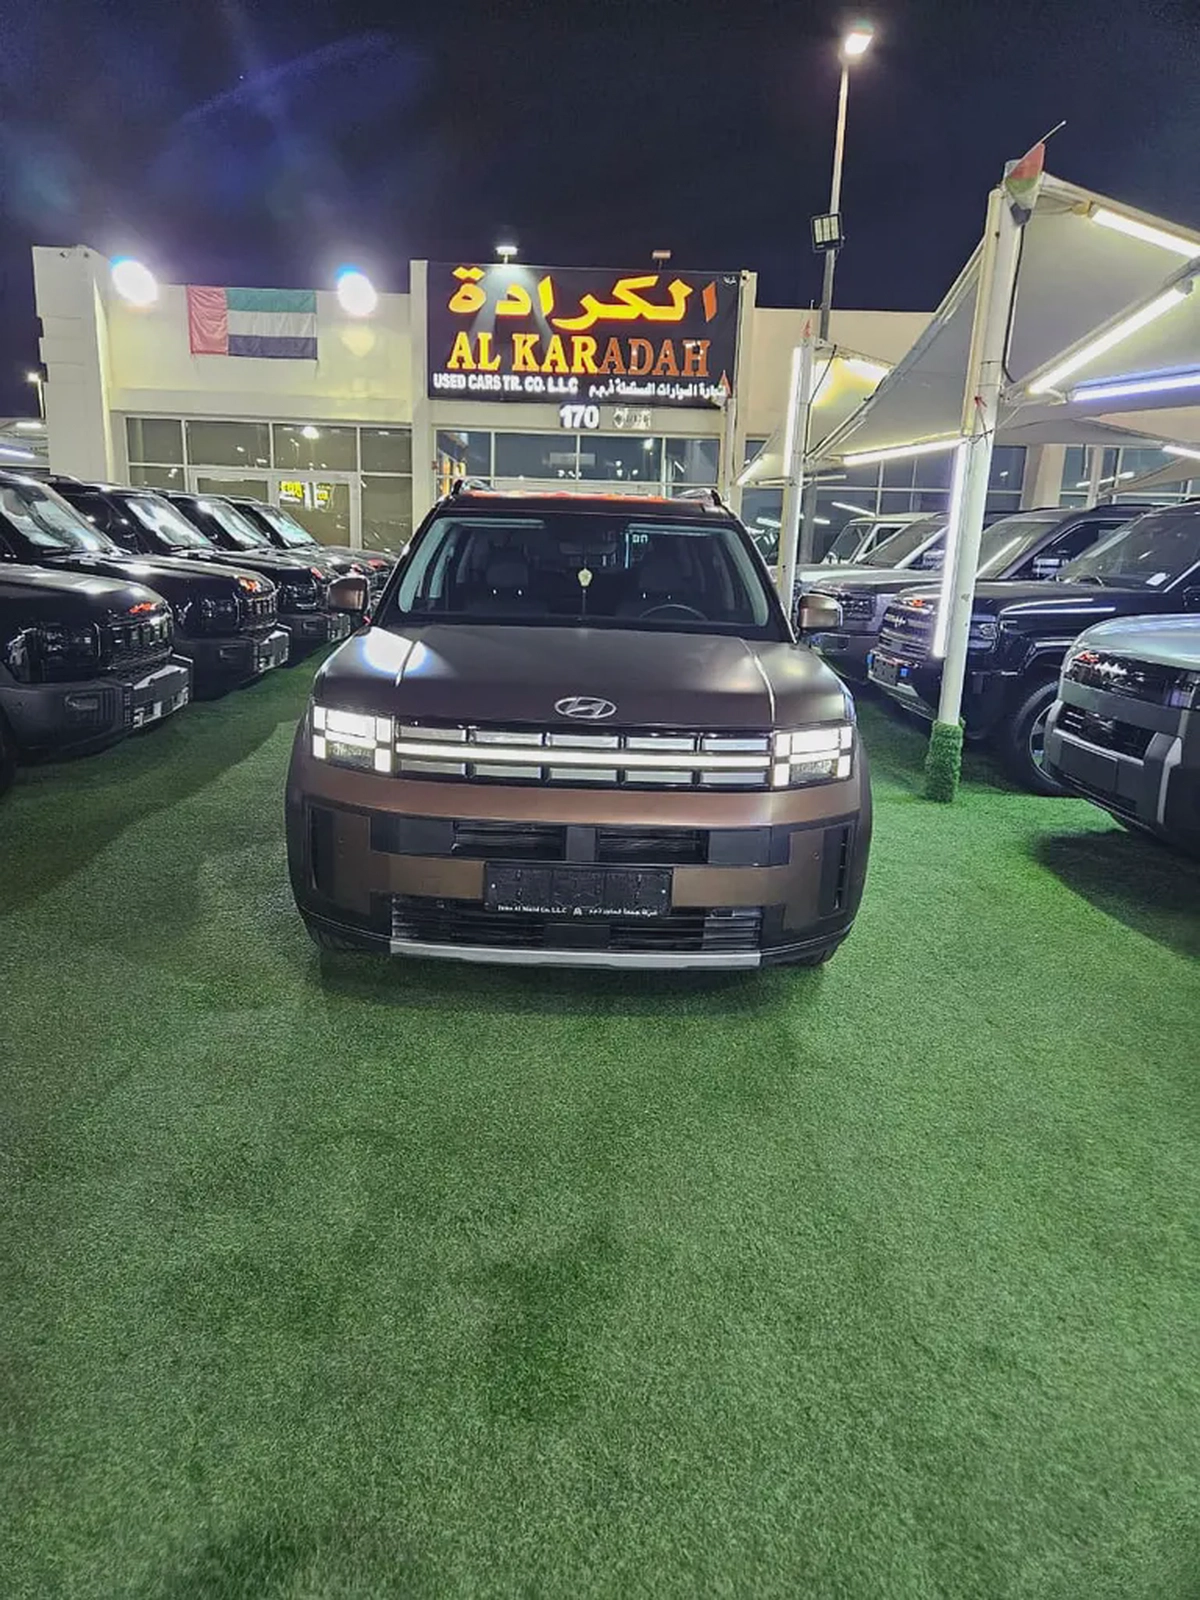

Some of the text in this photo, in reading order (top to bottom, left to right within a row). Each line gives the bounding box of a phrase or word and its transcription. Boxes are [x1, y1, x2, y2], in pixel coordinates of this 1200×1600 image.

[448, 265, 717, 331] الكرادة
[447, 331, 711, 377] AL KARADAH
[433, 373, 466, 389] USED
[468, 374, 501, 390] CARS
[502, 375, 523, 391] TR.
[524, 376, 546, 392] CO.
[559, 404, 600, 429] 170
